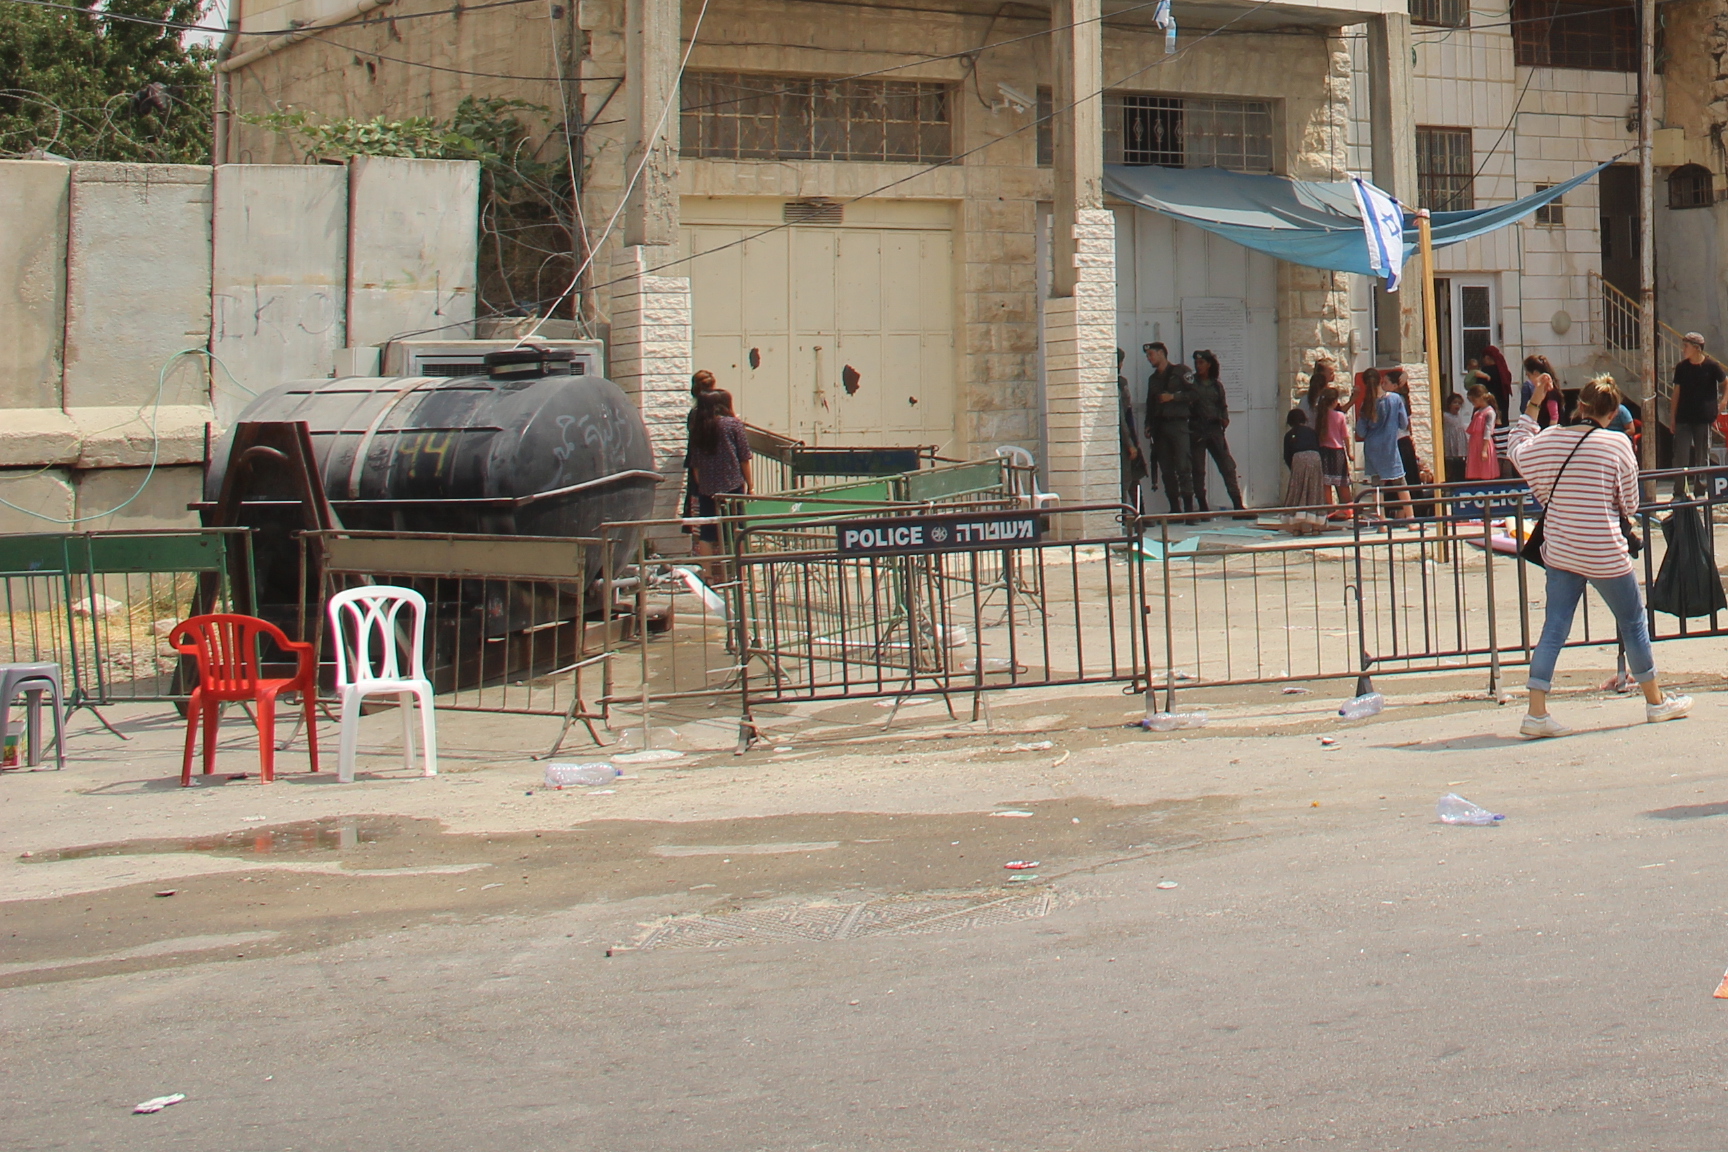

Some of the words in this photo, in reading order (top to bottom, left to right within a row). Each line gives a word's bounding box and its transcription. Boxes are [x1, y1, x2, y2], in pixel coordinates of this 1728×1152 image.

[1459, 488, 1534, 509] POLICE
[845, 526, 924, 549] POLICE
[956, 519, 1034, 543] משטרה
